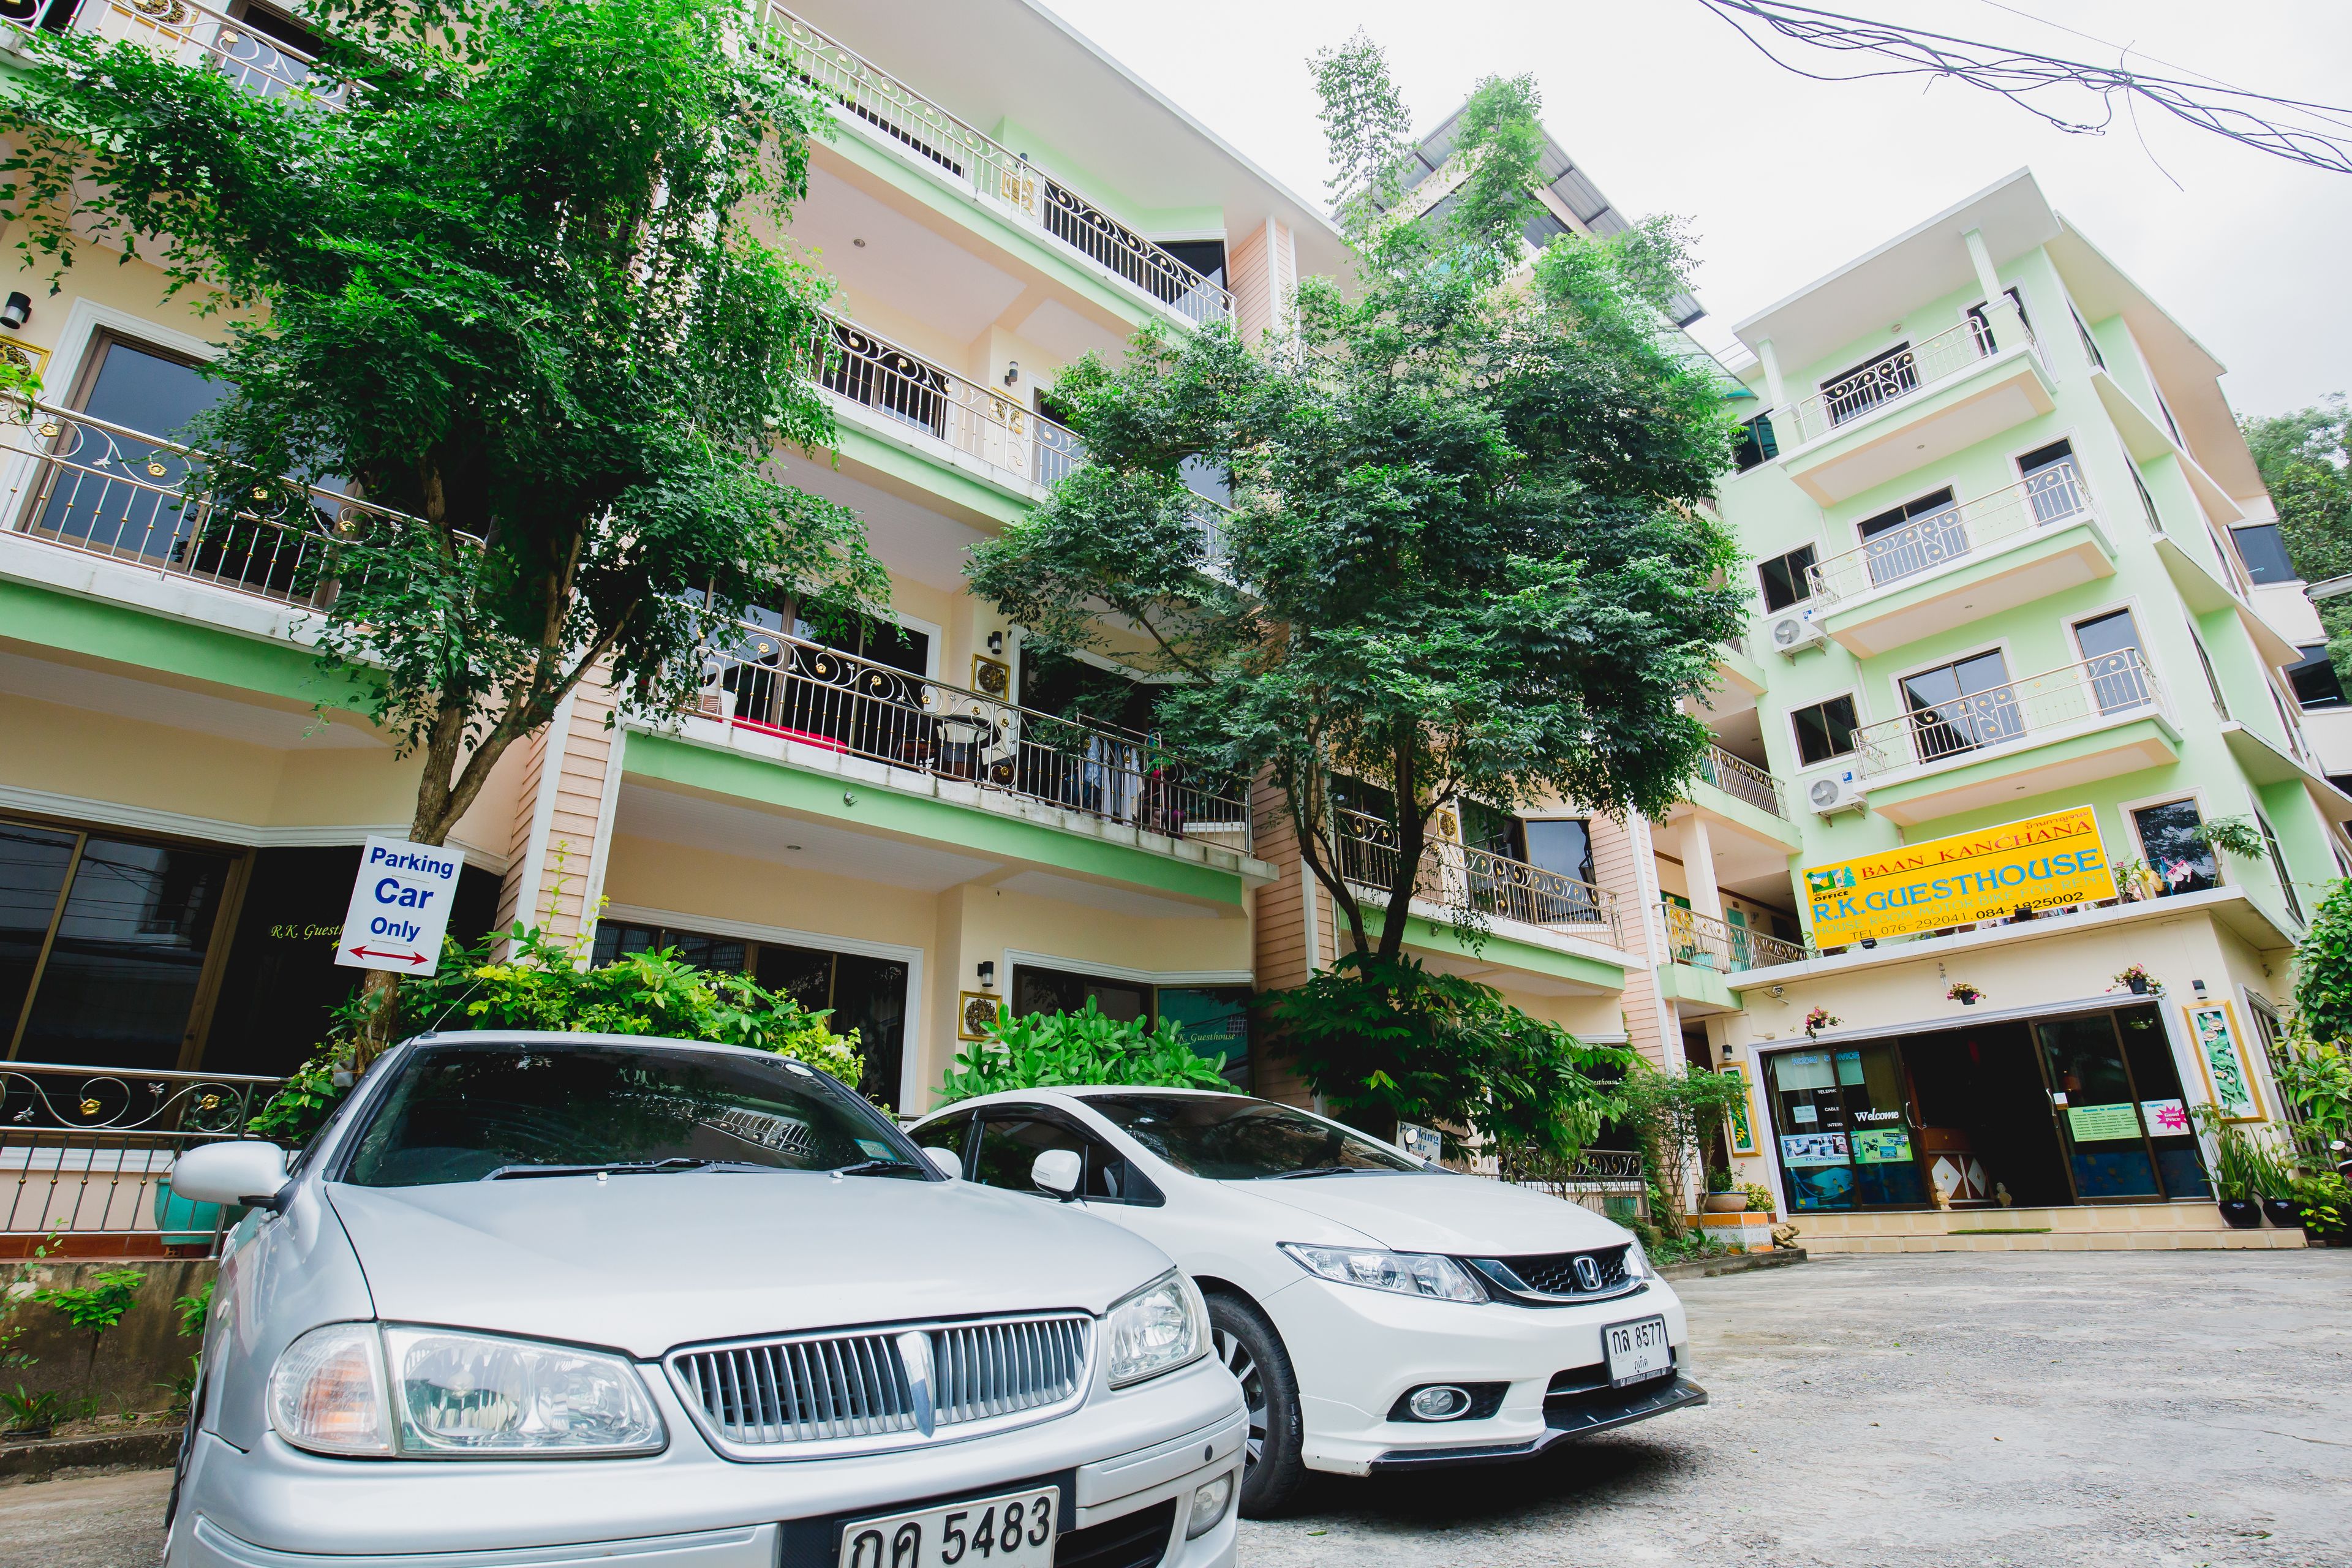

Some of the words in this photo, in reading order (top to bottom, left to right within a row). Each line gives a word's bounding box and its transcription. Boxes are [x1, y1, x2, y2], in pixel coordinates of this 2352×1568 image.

[369, 846, 454, 880] Parking
[1861, 855, 1924, 878] BAAN
[1939, 821, 2094, 862] KANCHANA
[374, 877, 434, 910] Car
[1814, 891, 1849, 902] OFFICE
[1816, 919, 1864, 935] HOUSE
[1870, 910, 1912, 925] ROOM
[1919, 899, 1974, 917] MOTOR
[1978, 889, 2016, 907] BIKE
[2020, 883, 2054, 898] FOR
[2061, 872, 2106, 891] RENT
[271, 925, 298, 938] R.K.
[304, 924, 345, 940] Guest
[371, 916, 421, 943] Only
[1191, 1031, 1235, 1044] Guesthouse
[1792, 1055, 1818, 1065] ROOM
[1823, 1051, 1860, 1062] SRVICE
[1855, 1107, 1899, 1121] Welcome
[1400, 1121, 1439, 1147] Pking
[1612, 1329, 1631, 1355] กล
[1635, 1321, 1662, 1348] 8577
[941, 1496, 1051, 1565] 5483
